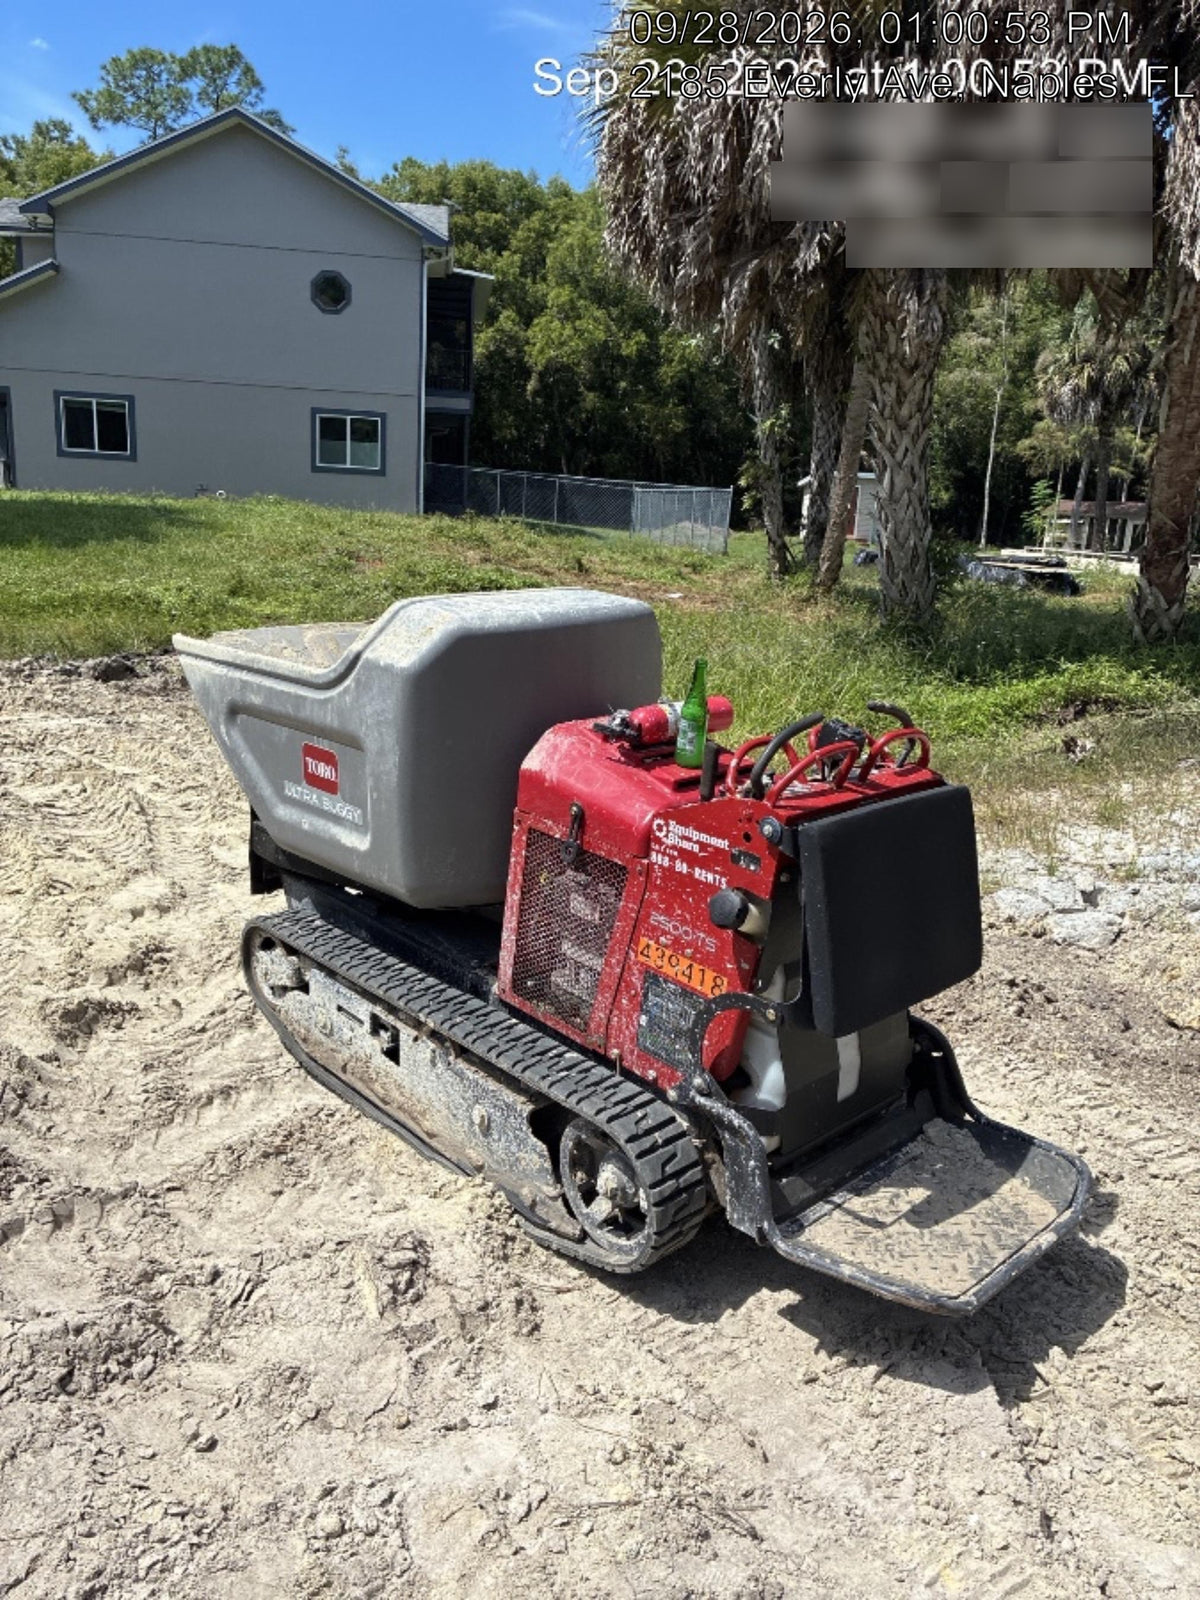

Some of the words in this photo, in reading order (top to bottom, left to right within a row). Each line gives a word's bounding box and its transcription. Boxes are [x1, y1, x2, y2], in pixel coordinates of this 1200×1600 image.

[305, 756, 338, 783] TORO
[284, 780, 320, 807] ULTRA
[322, 797, 363, 826] BUGGY
[667, 832, 700, 853] Share
[668, 819, 730, 850] Equipment
[639, 942, 725, 998] 439418
